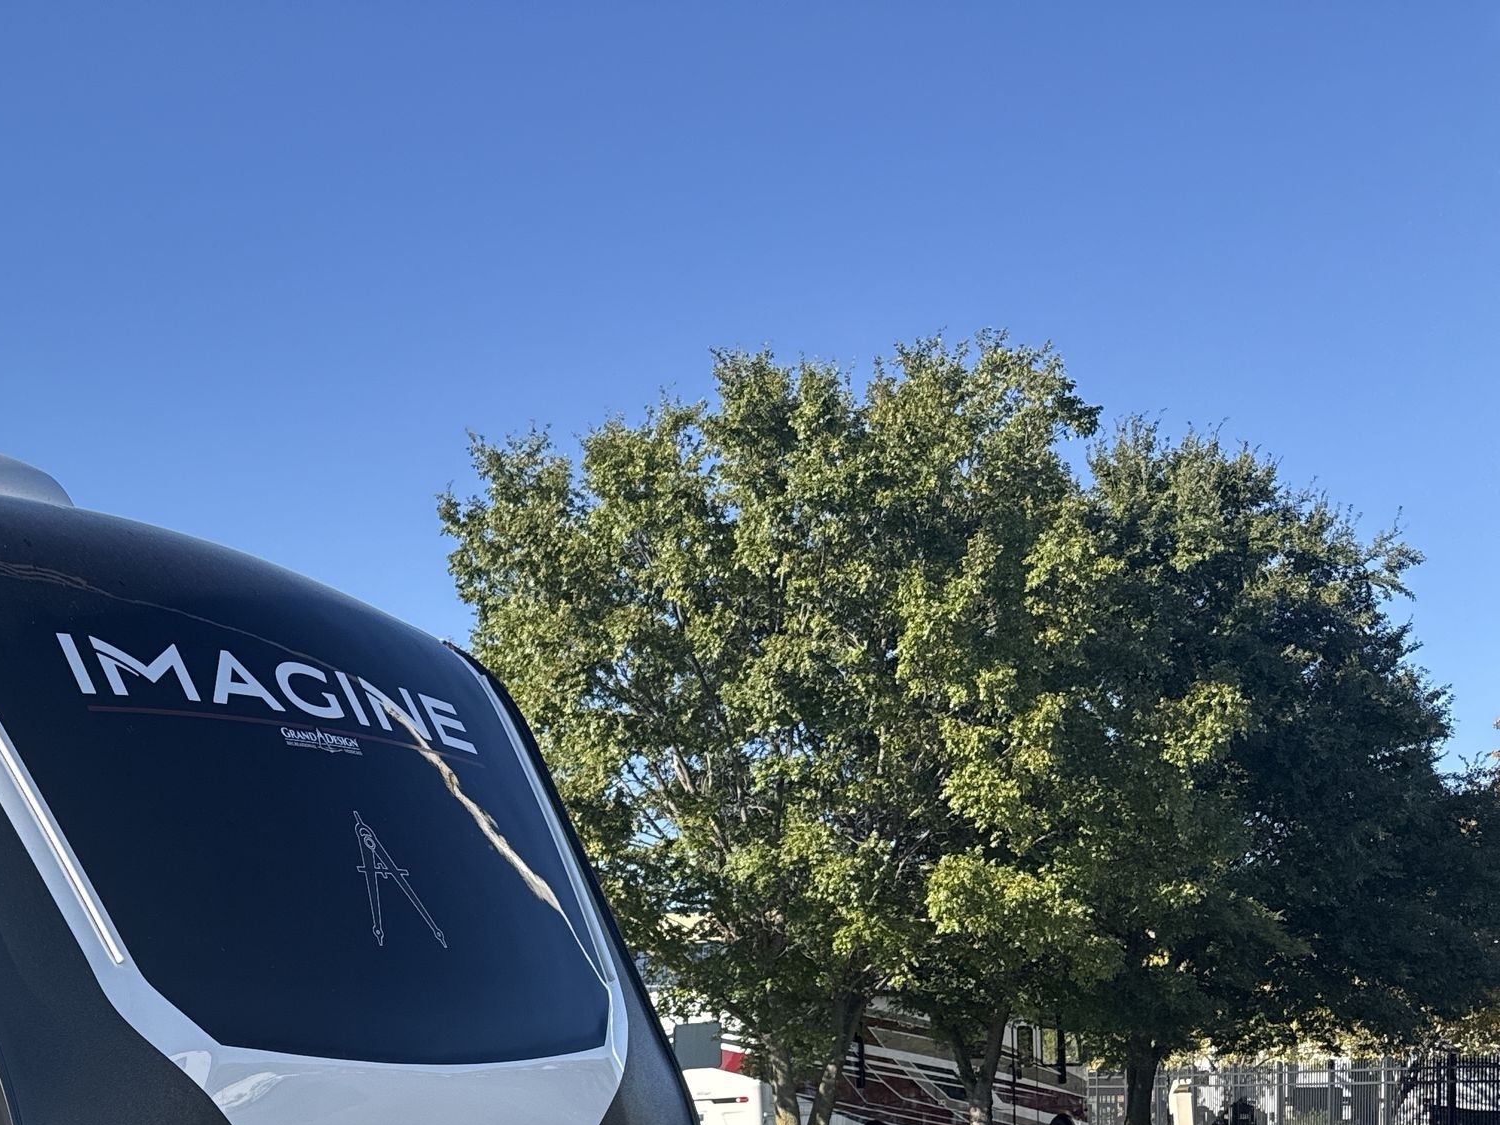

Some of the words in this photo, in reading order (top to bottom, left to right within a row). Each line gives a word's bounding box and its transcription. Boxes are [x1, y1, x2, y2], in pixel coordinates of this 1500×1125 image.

[56, 633, 478, 754] IMAGINE
[281, 727, 318, 742] GRAND
[323, 733, 359, 748] DESIGN
